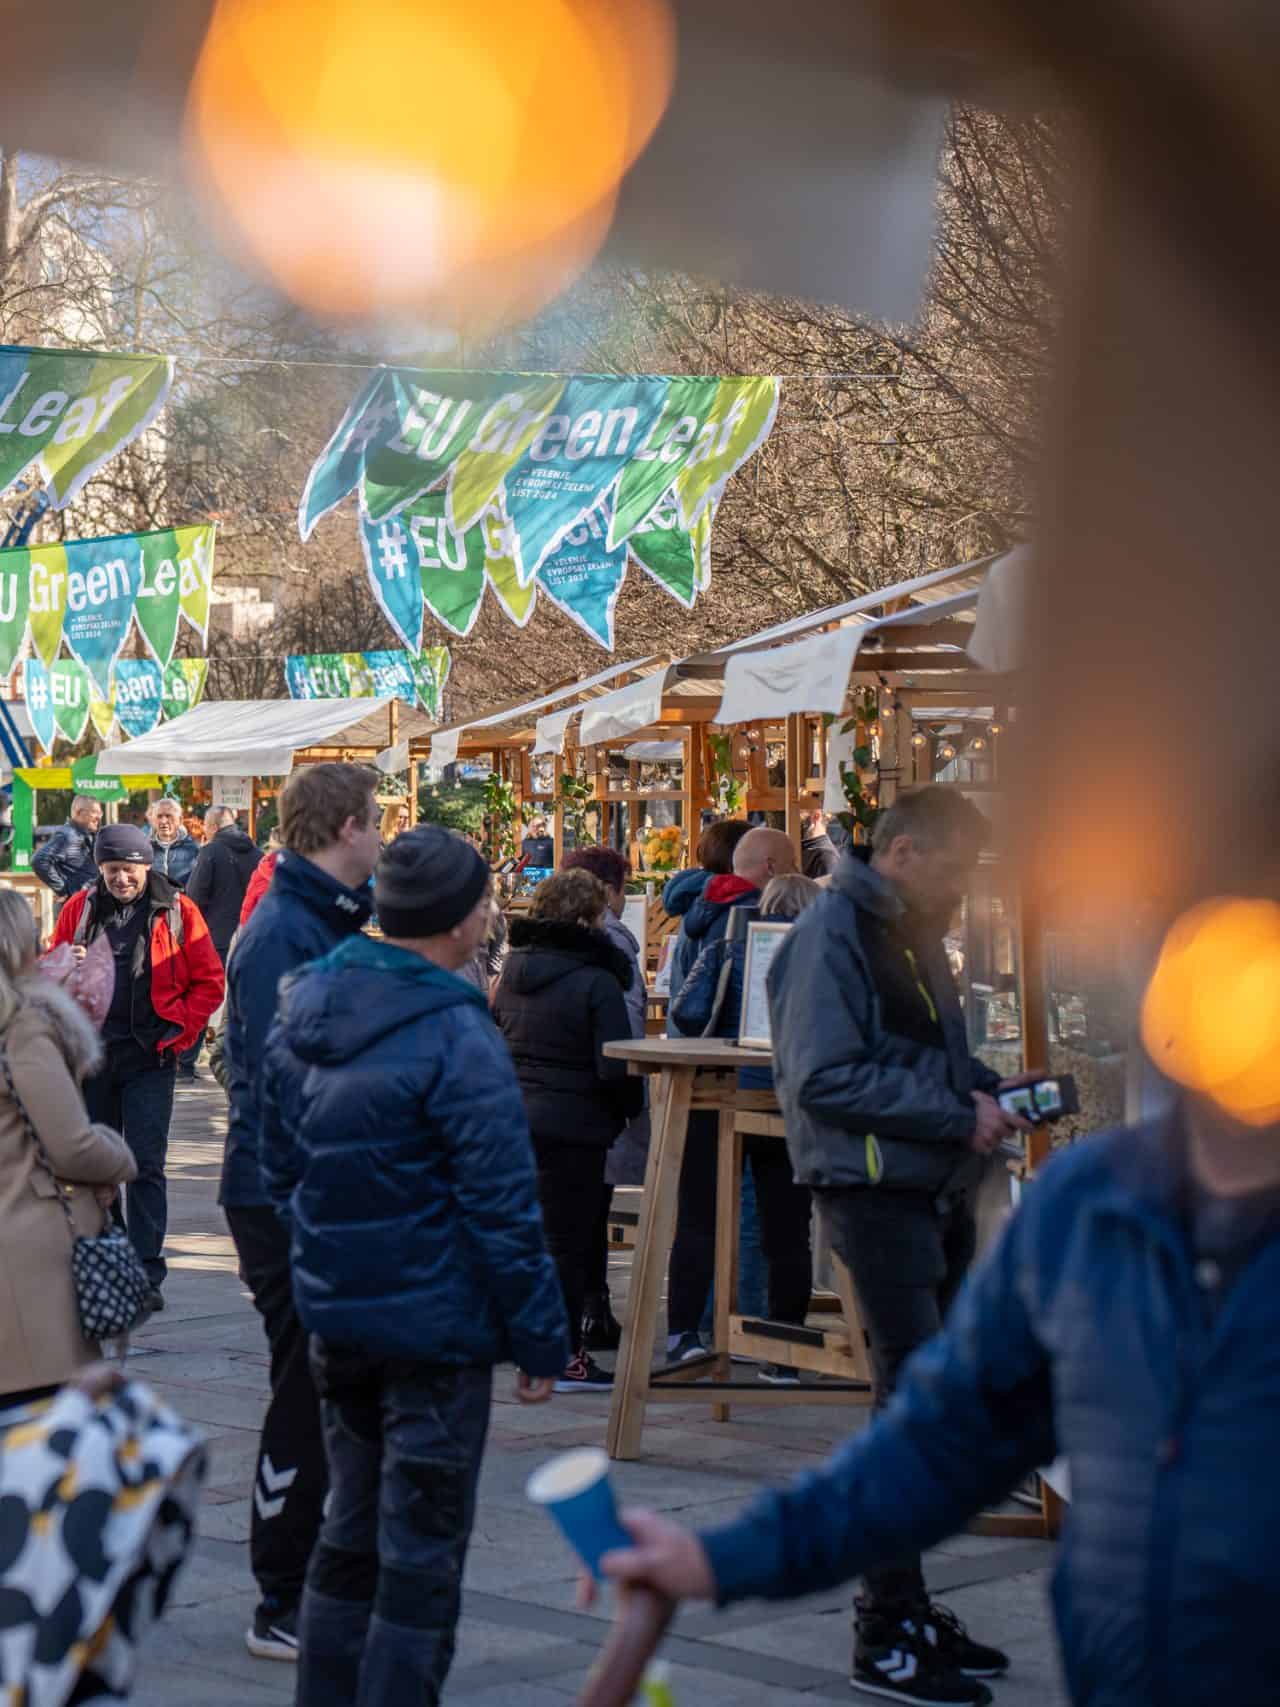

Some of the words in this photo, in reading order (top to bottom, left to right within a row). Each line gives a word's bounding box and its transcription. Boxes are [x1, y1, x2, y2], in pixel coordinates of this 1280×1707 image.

[470, 392, 638, 463] Green
[633, 398, 746, 468] Leaf
[29, 558, 131, 612] Green
[136, 534, 211, 597] Leaf
[377, 515, 468, 580] #EU
[30, 671, 81, 709] #EU
